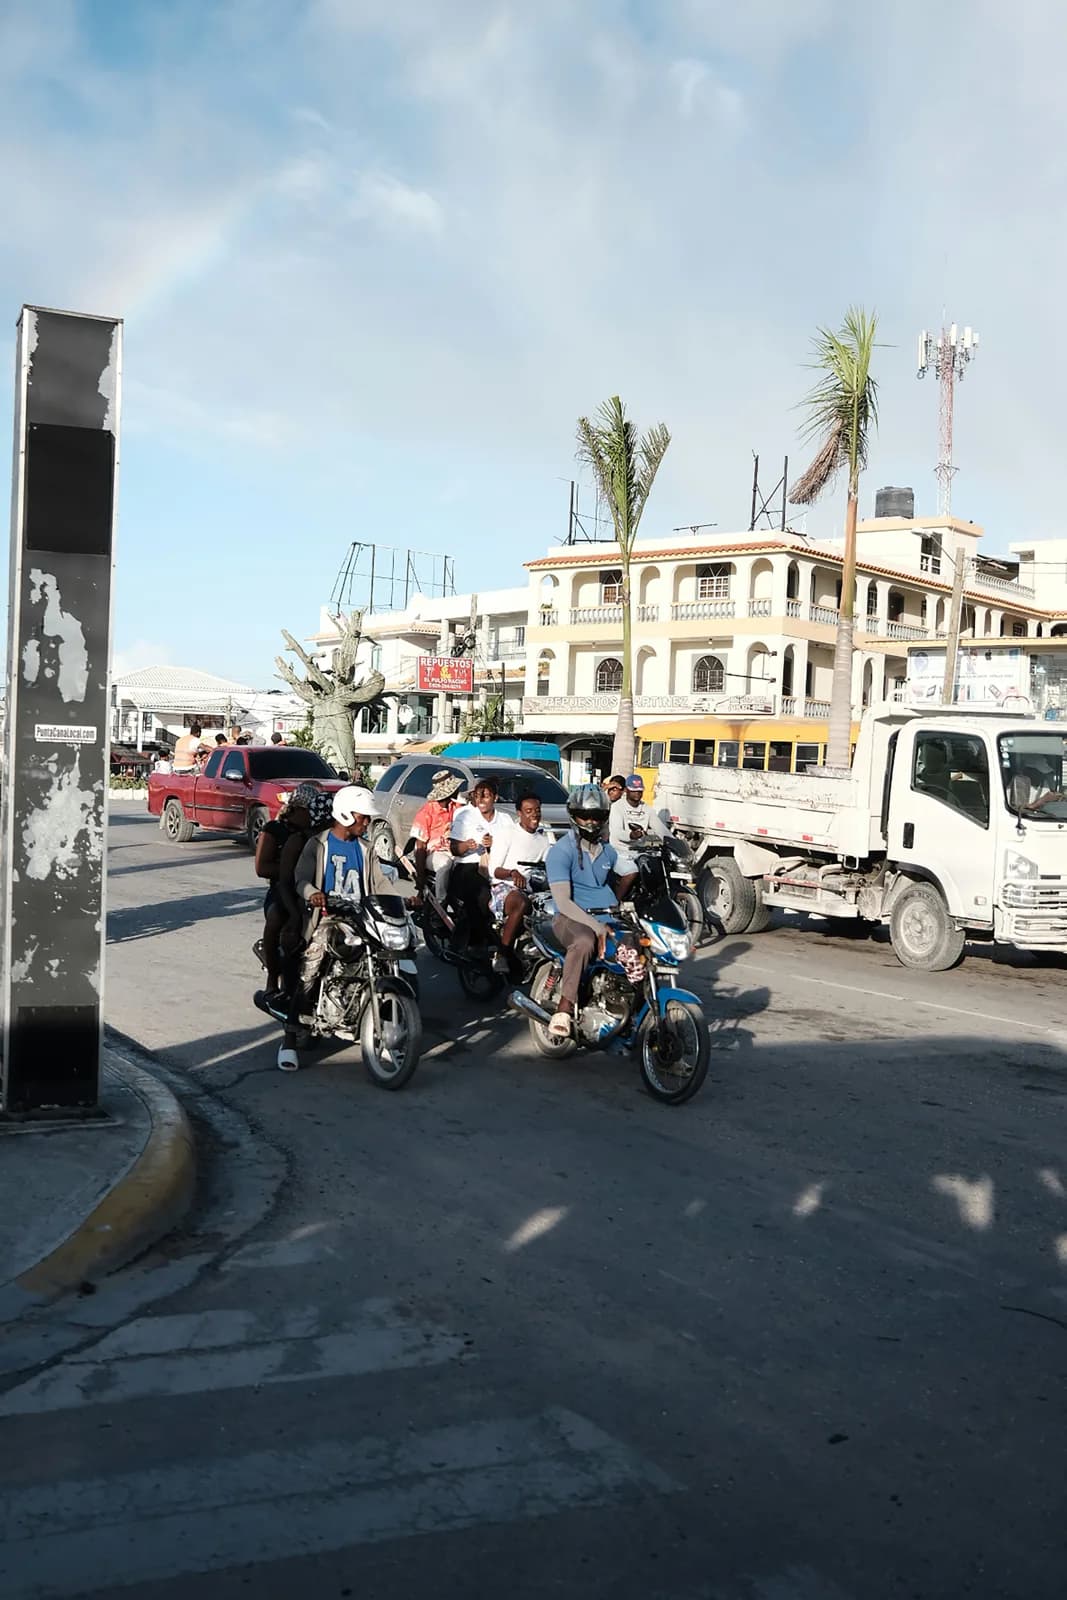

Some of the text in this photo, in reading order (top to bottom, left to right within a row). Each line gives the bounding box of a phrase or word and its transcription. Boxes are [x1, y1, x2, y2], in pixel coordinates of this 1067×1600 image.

[420, 657, 470, 668] REPUESTOS
[545, 695, 689, 708] REPUESTOS ARTINEZ
[328, 854, 361, 902] LA
